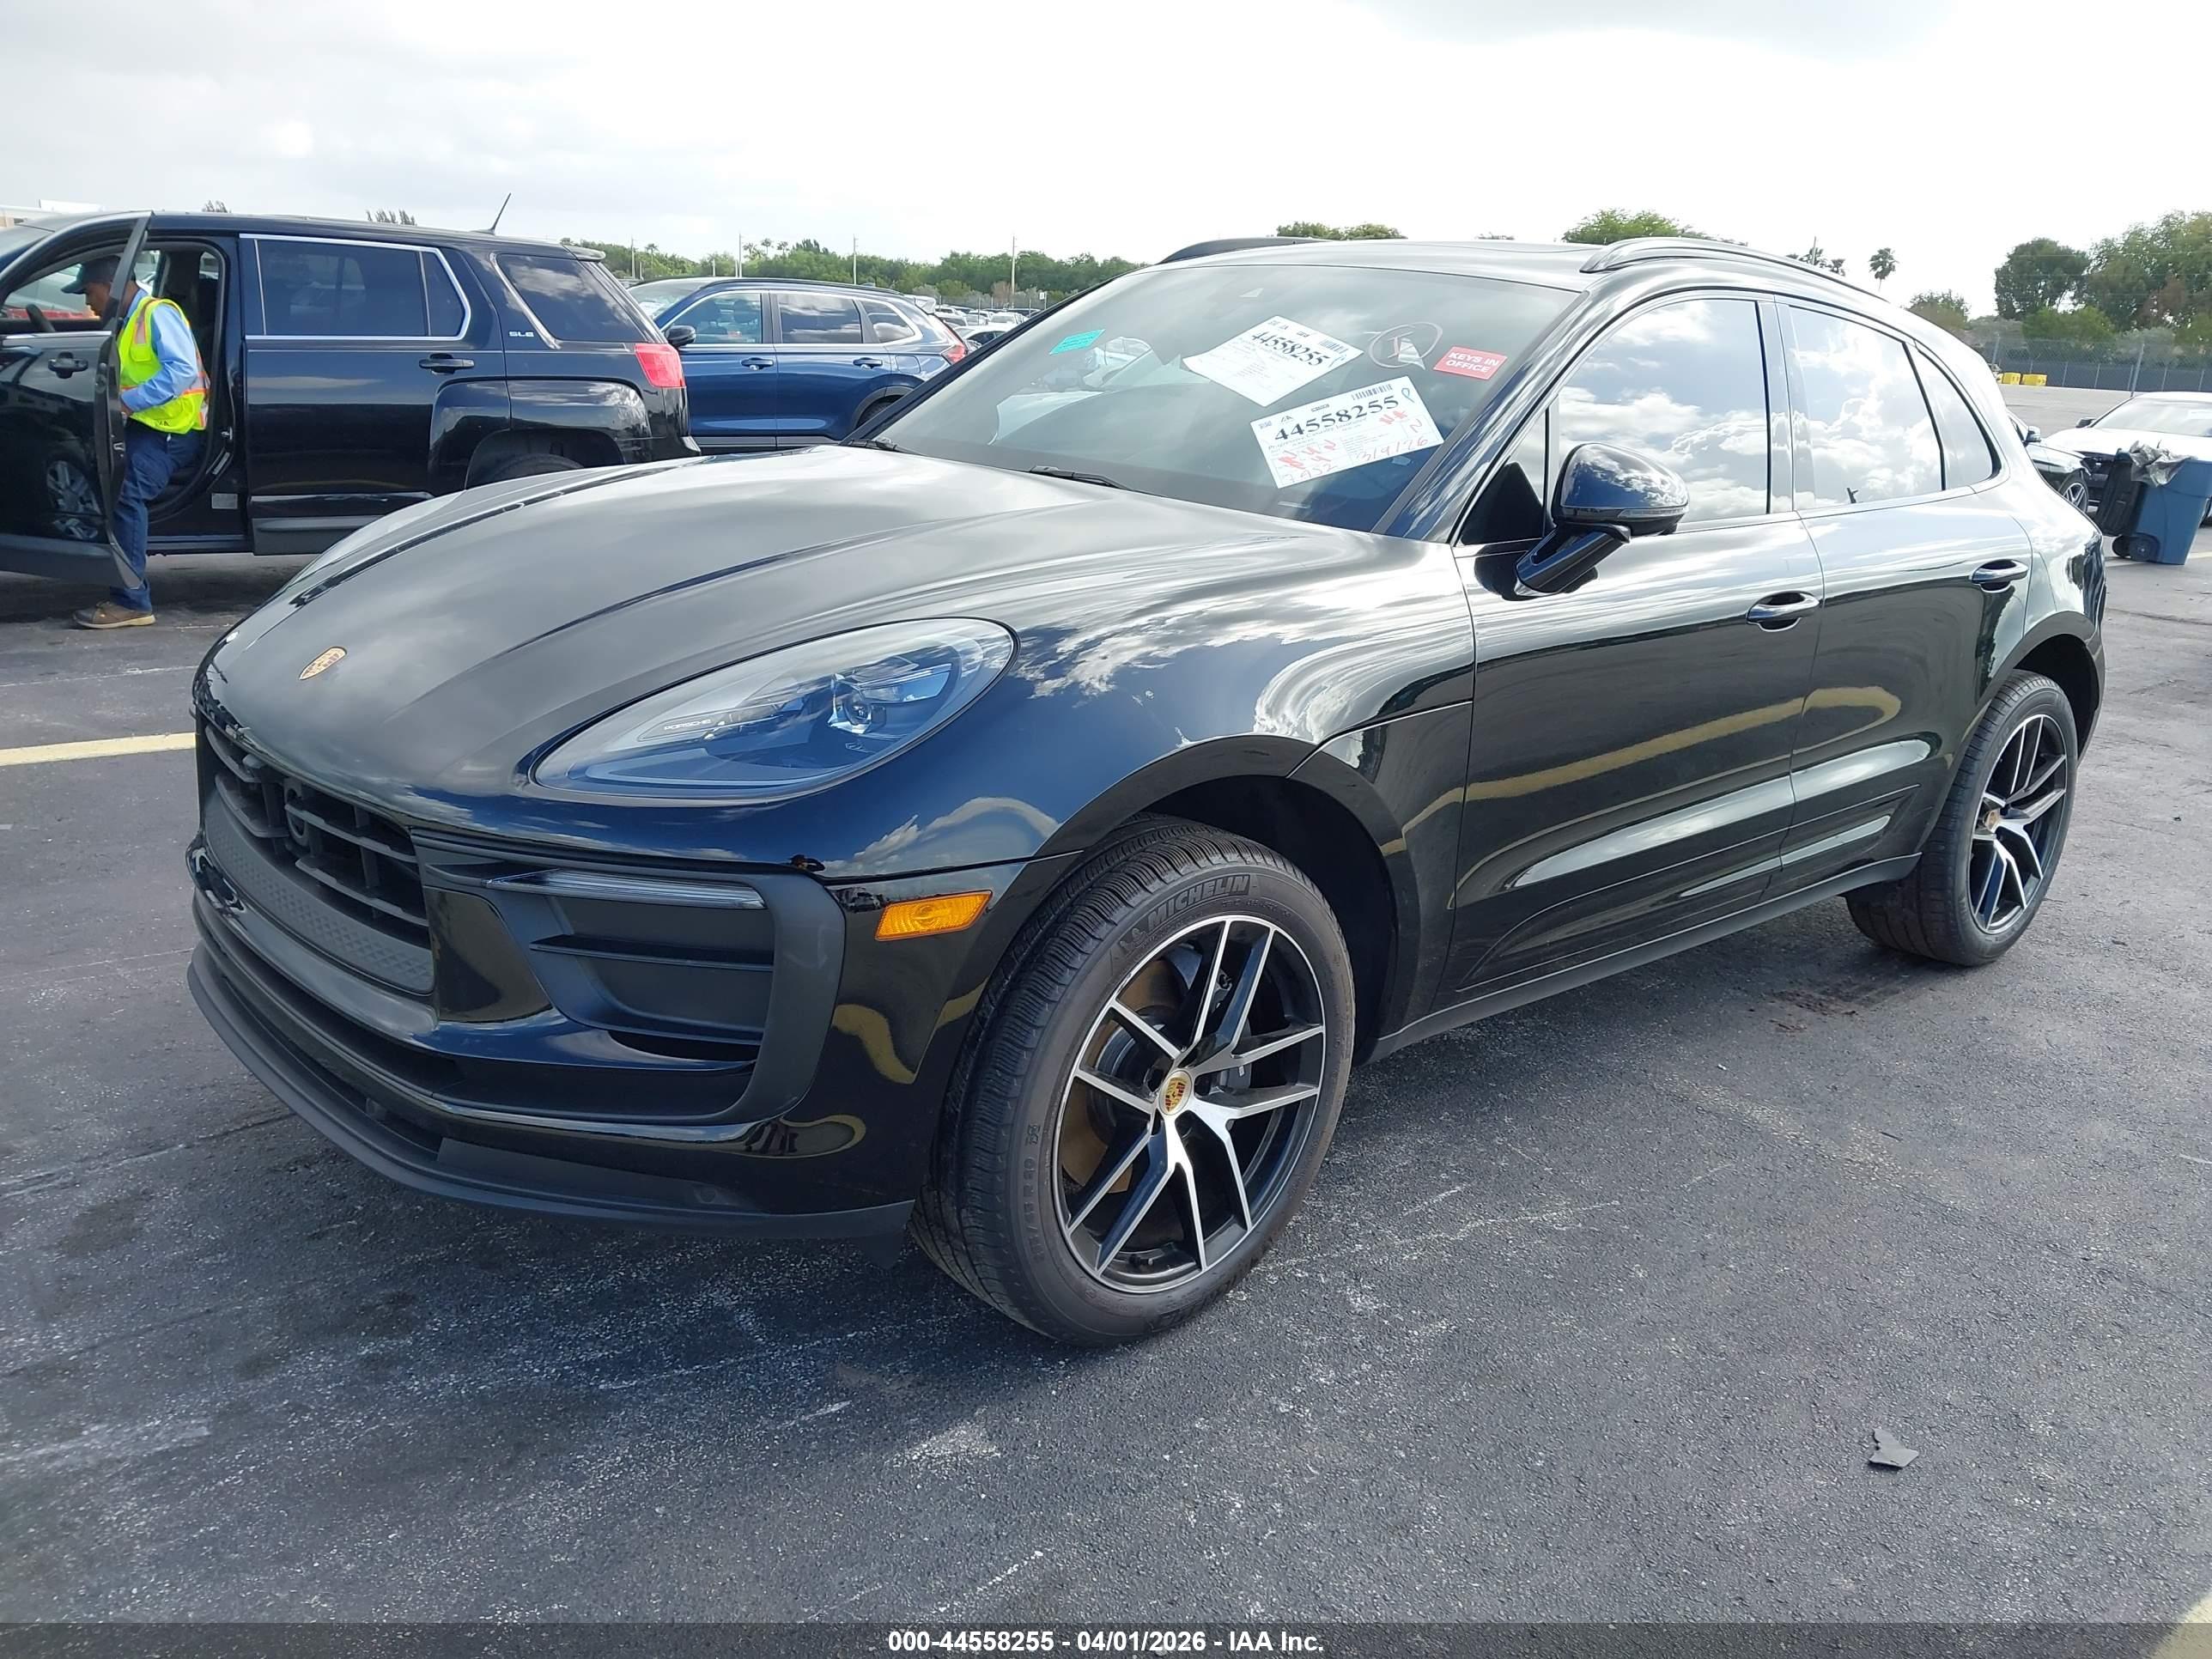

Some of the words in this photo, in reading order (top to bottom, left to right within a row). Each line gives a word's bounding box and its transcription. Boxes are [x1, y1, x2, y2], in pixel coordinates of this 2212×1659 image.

[1251, 331, 1331, 366] 44558255
[1448, 352, 1482, 363] KEYS
[1484, 358, 1499, 367] IN
[1446, 360, 1492, 373] OFFICE
[1274, 396, 1399, 441] 44558255
[664, 719, 712, 730] PORSCHE
[1147, 875, 1250, 931] MICHELIN
